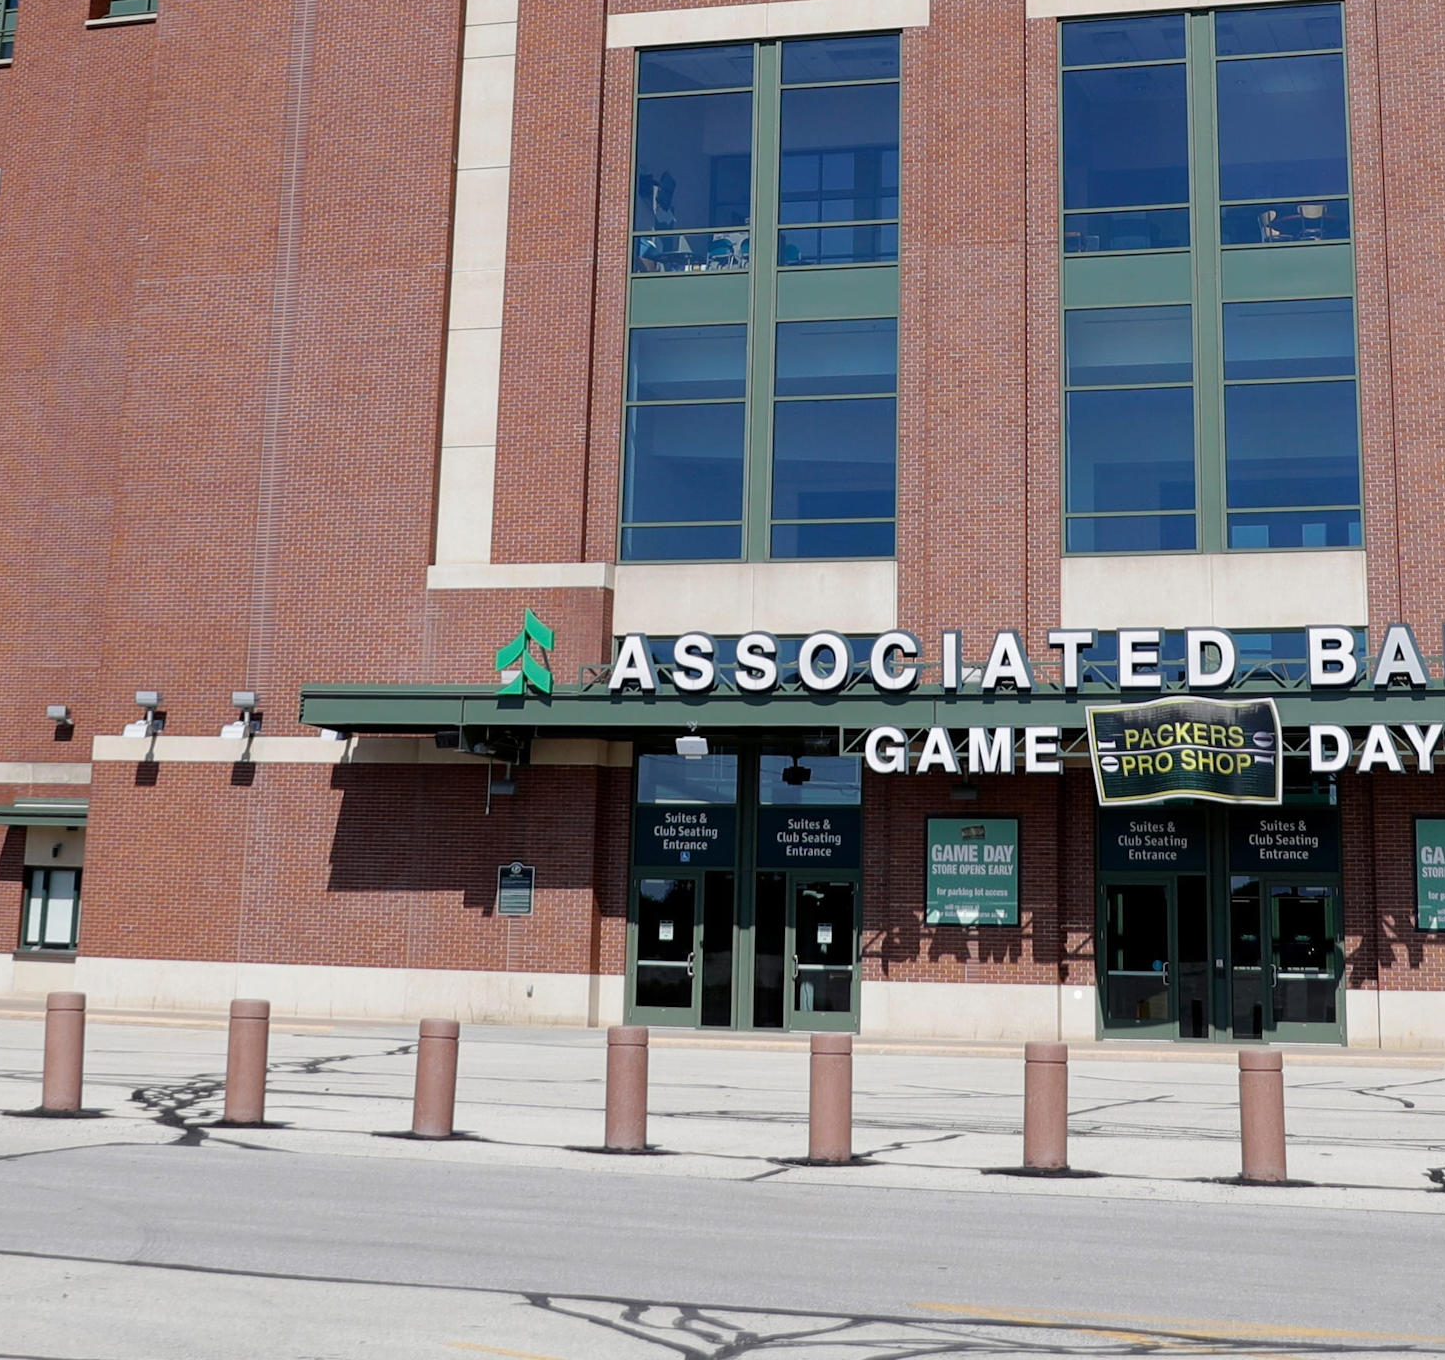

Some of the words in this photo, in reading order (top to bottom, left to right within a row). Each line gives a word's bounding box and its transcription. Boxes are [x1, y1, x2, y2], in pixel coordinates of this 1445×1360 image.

[608, 626, 1238, 692] ASSOCIATED
[1123, 721, 1245, 750] PACKERS
[864, 725, 1062, 774] GAME
[1307, 723, 1445, 773] DAY
[1120, 752, 1174, 777] PRO
[1180, 749, 1252, 775] SHOP
[664, 812, 697, 824] Suites
[699, 813, 708, 823] &
[787, 818, 820, 830] Suites
[822, 819, 831, 830] &
[1129, 821, 1164, 833] Suites
[1167, 822, 1176, 832] &
[1259, 820, 1296, 832] Suites
[1298, 820, 1307, 831] &
[653, 826, 676, 837] Club
[678, 826, 718, 839] Seating
[776, 831, 799, 843] Club
[801, 832, 842, 845] Seating
[663, 839, 708, 850] Entrance
[1117, 835, 1142, 846] Club
[1144, 835, 1188, 849] Seating
[1248, 834, 1273, 846] Club
[1275, 834, 1319, 848] Seating
[786, 845, 832, 857] Entrance
[931, 844, 979, 862] GAME
[983, 845, 1014, 862] DAY
[1128, 849, 1177, 861] Entrance
[1259, 848, 1309, 860] Entrance
[932, 864, 958, 875] STORE
[959, 864, 986, 875] OPENS
[988, 864, 1014, 875] EARLY
[936, 887, 947, 896] for
[947, 887, 974, 898] parking
[974, 888, 984, 896] lot
